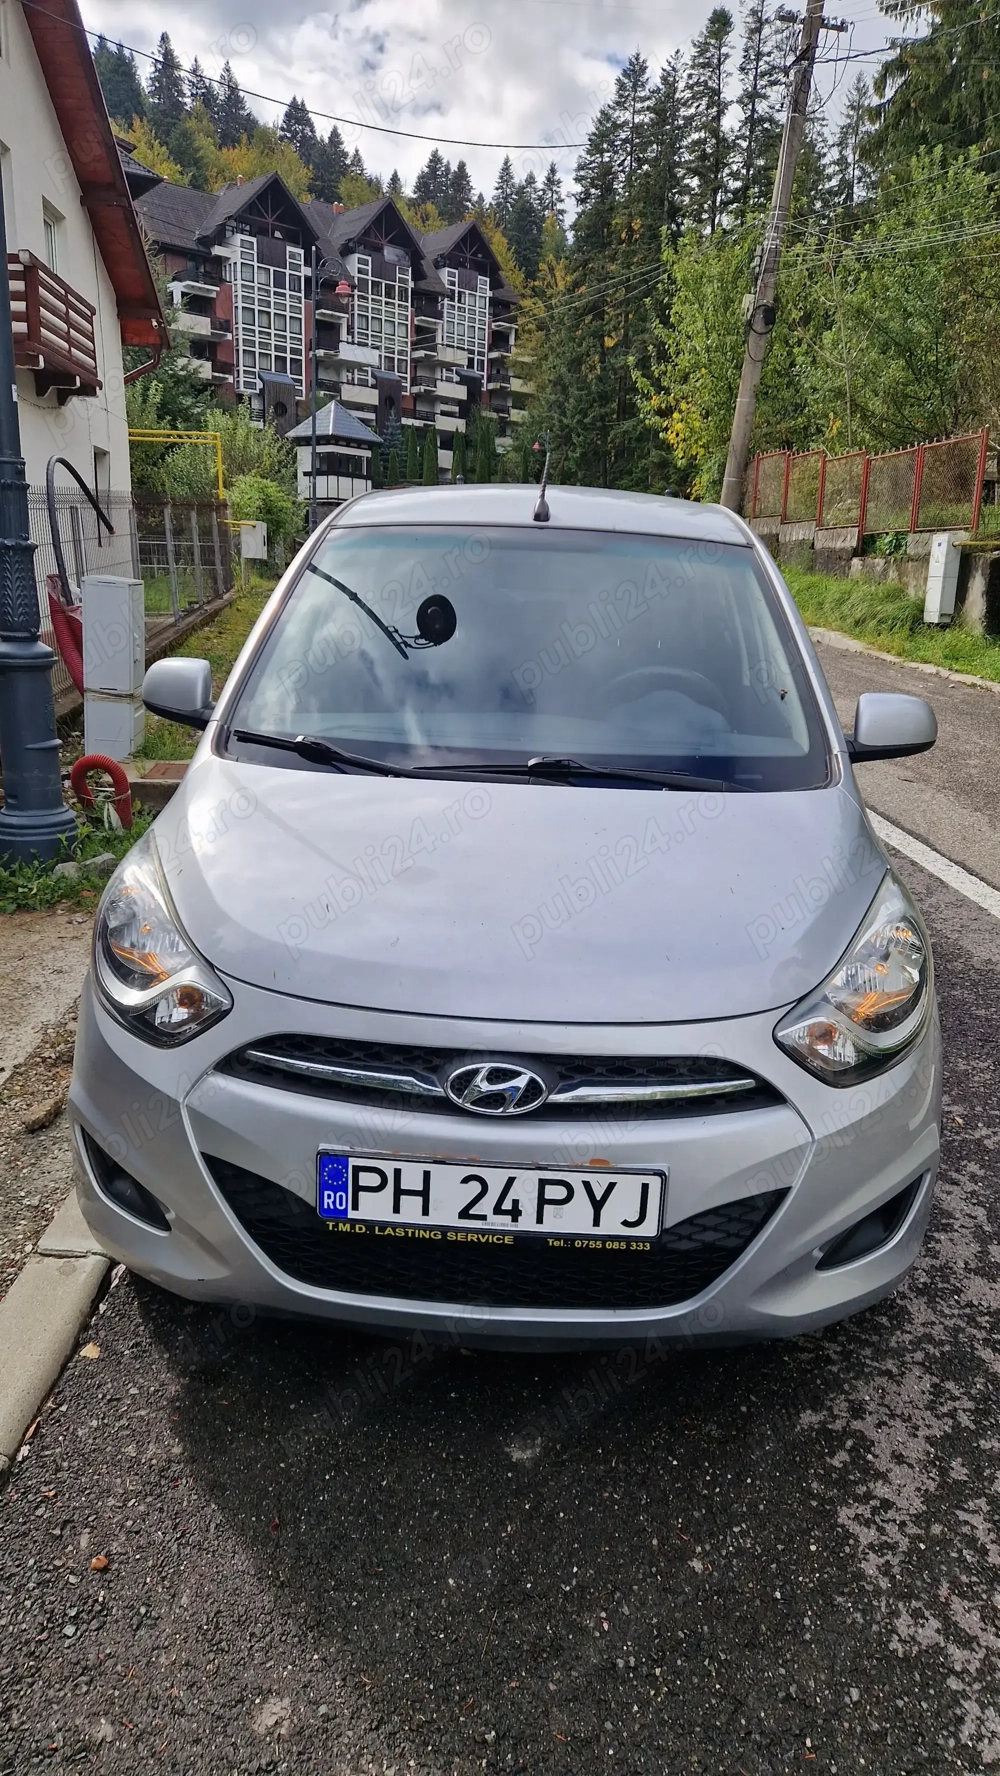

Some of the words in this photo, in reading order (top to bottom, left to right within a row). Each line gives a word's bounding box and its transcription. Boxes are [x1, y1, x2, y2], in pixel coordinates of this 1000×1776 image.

[324, 1191, 346, 1210] RO
[351, 1164, 431, 1217] PH
[326, 1221, 370, 1234] T.M.D.
[375, 1226, 442, 1240] LASTING
[446, 1231, 514, 1245] SERVICE
[547, 1238, 571, 1248] Tel.:
[574, 1239, 602, 1249] 0755
[605, 1241, 626, 1250] 085
[630, 1241, 650, 1251] 333
